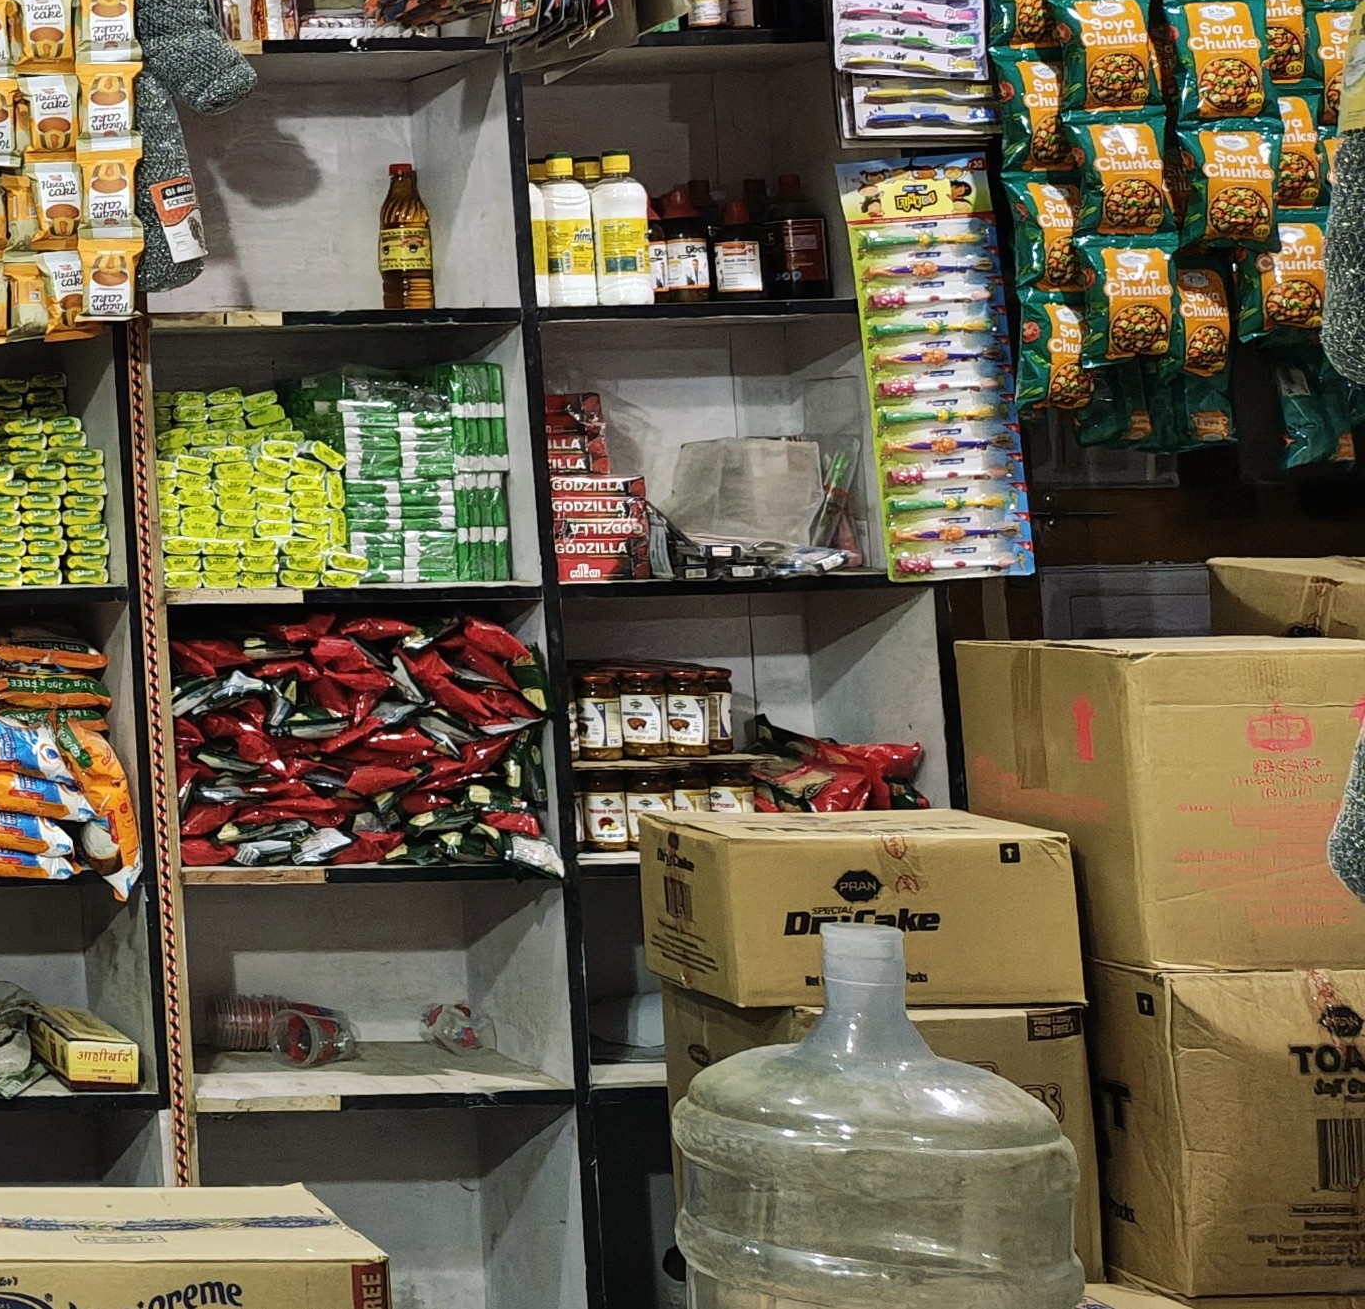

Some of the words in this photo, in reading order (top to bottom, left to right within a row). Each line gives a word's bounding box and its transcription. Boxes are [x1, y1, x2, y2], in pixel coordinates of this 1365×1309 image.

[33, 9, 63, 19] cake
[1199, 23, 1243, 37] Soya
[1083, 32, 1148, 45] Chunks
[1189, 36, 1258, 50] Chunks
[1214, 152, 1259, 166] Soya
[552, 480, 624, 491] GODZILLA
[552, 501, 625, 512] GODZILLA
[555, 542, 627, 554] GODZILLA
[839, 881, 876, 891] PRAN
[812, 906, 854, 915] SPECIAL
